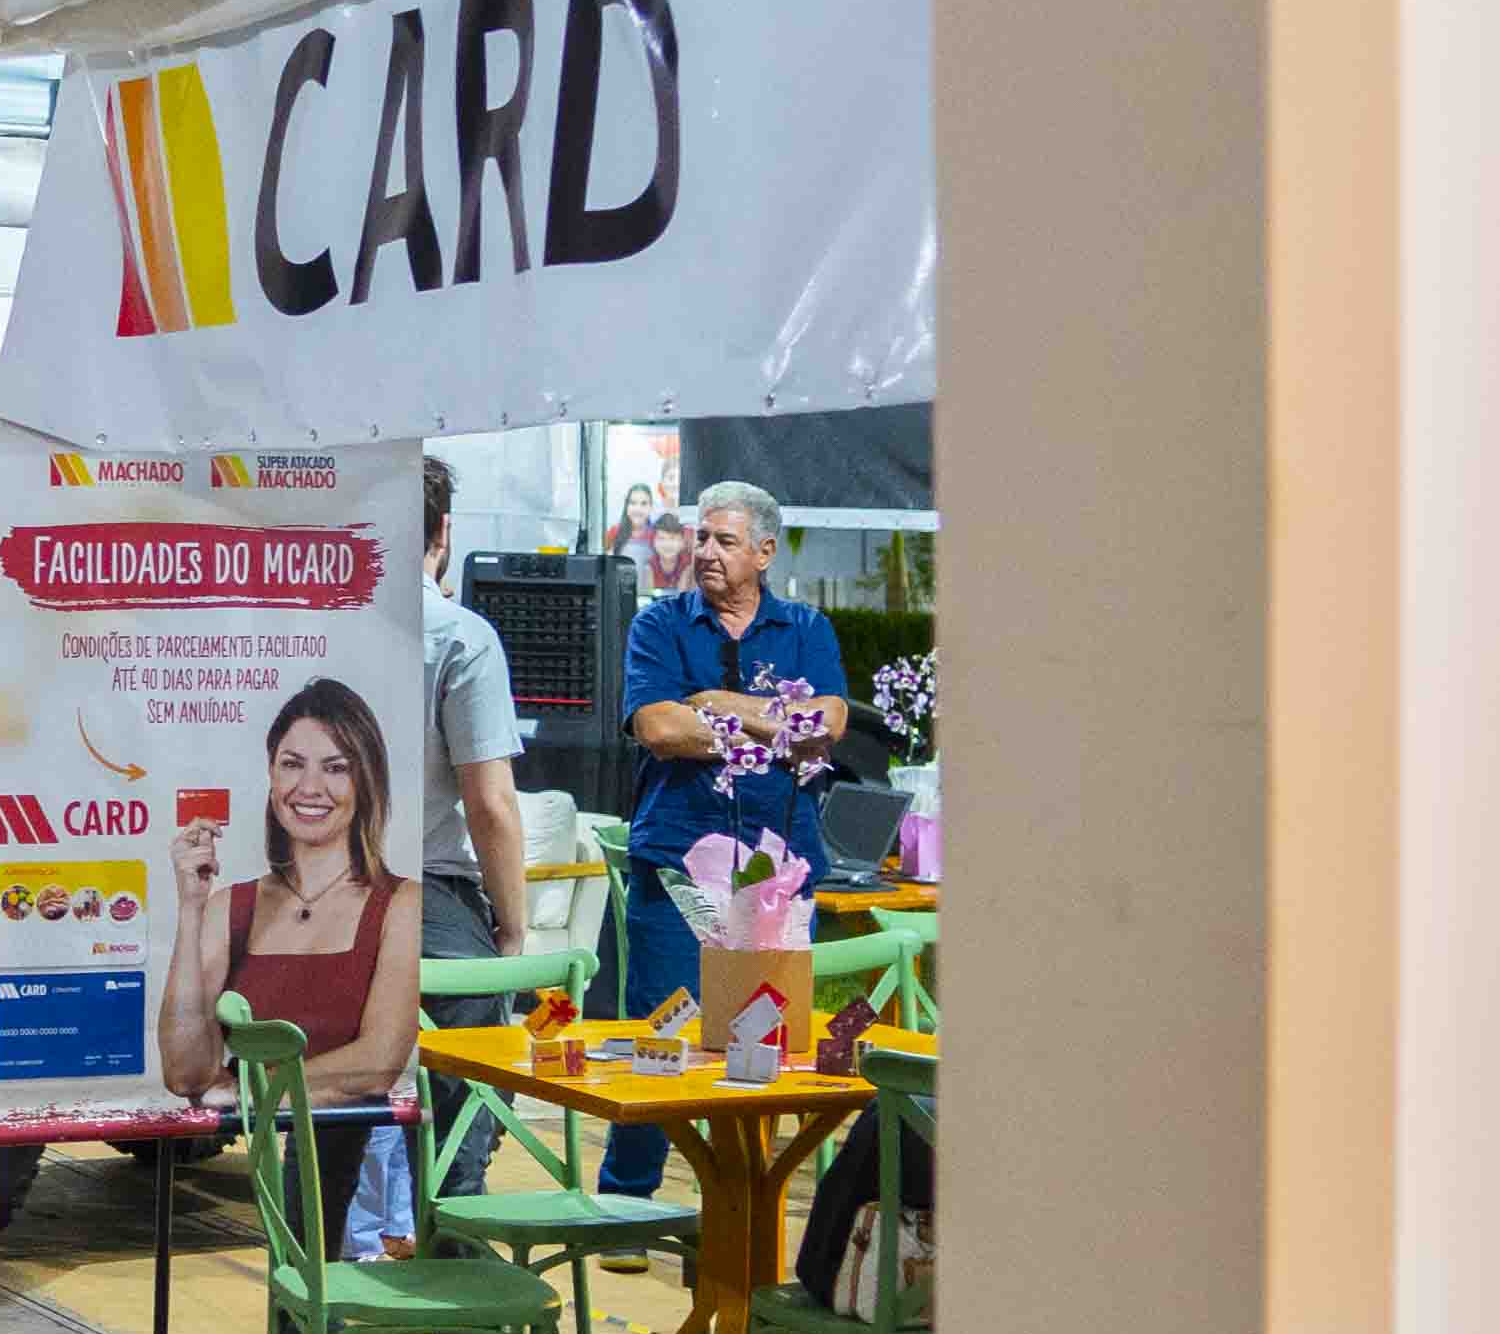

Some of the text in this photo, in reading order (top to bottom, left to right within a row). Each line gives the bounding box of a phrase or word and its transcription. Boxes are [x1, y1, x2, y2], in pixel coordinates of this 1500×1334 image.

[97, 460, 185, 483] MACHADO
[256, 455, 336, 470] SUPER ATACADO
[256, 469, 337, 489] MACHADO
[33, 535, 354, 586] FACILIDADES DO MCARD
[136, 634, 152, 658] DE
[156, 634, 253, 658] PARCELAMENTO
[257, 634, 328, 658] FACILITADO
[112, 664, 280, 691] ATÉ 40 DIAS PARA PAGAR
[146, 698, 175, 724] SEM
